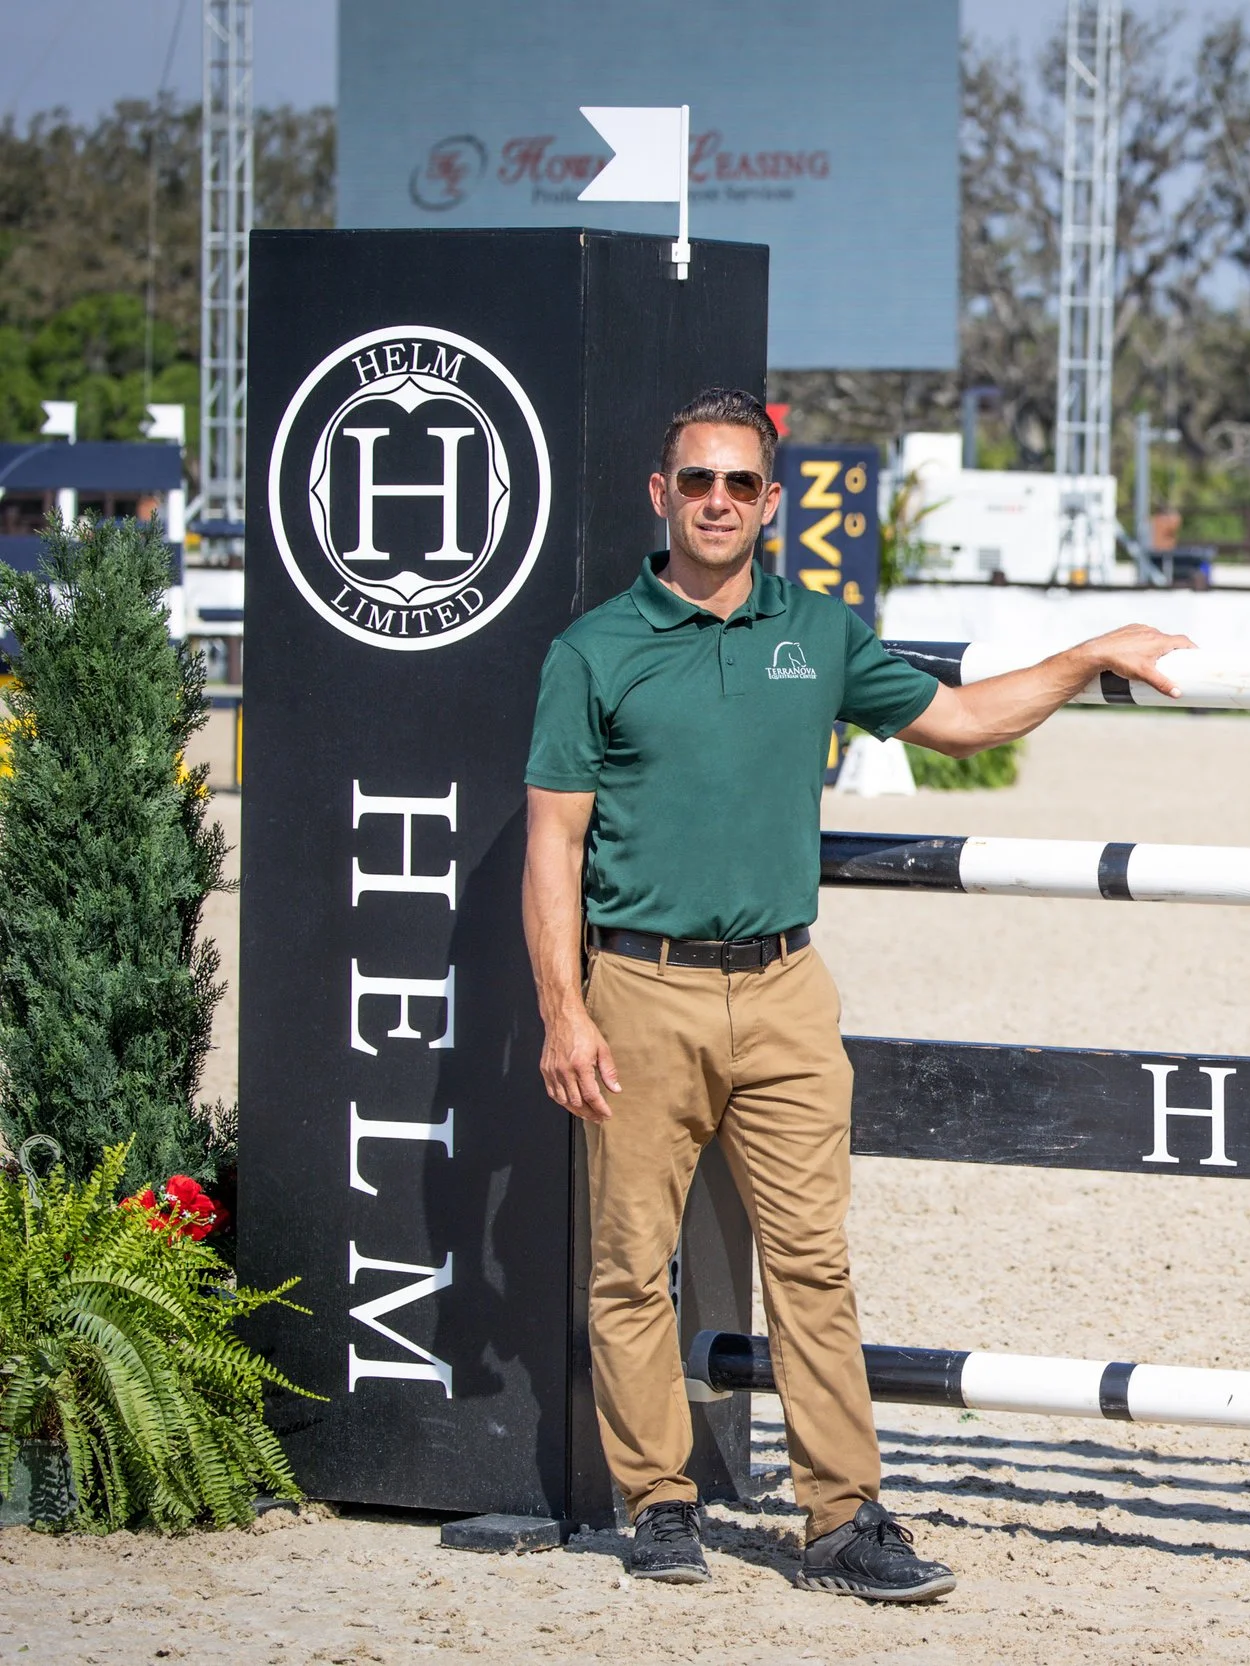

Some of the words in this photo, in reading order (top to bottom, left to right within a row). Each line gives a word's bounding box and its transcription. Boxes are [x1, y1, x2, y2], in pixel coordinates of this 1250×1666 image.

[498, 133, 608, 184] HOW
[351, 342, 466, 386] HELM
[343, 427, 475, 560] H
[330, 584, 484, 635] LIMITED
[765, 667, 816, 678] TERRANOVA
[349, 780, 457, 1399] HELM
